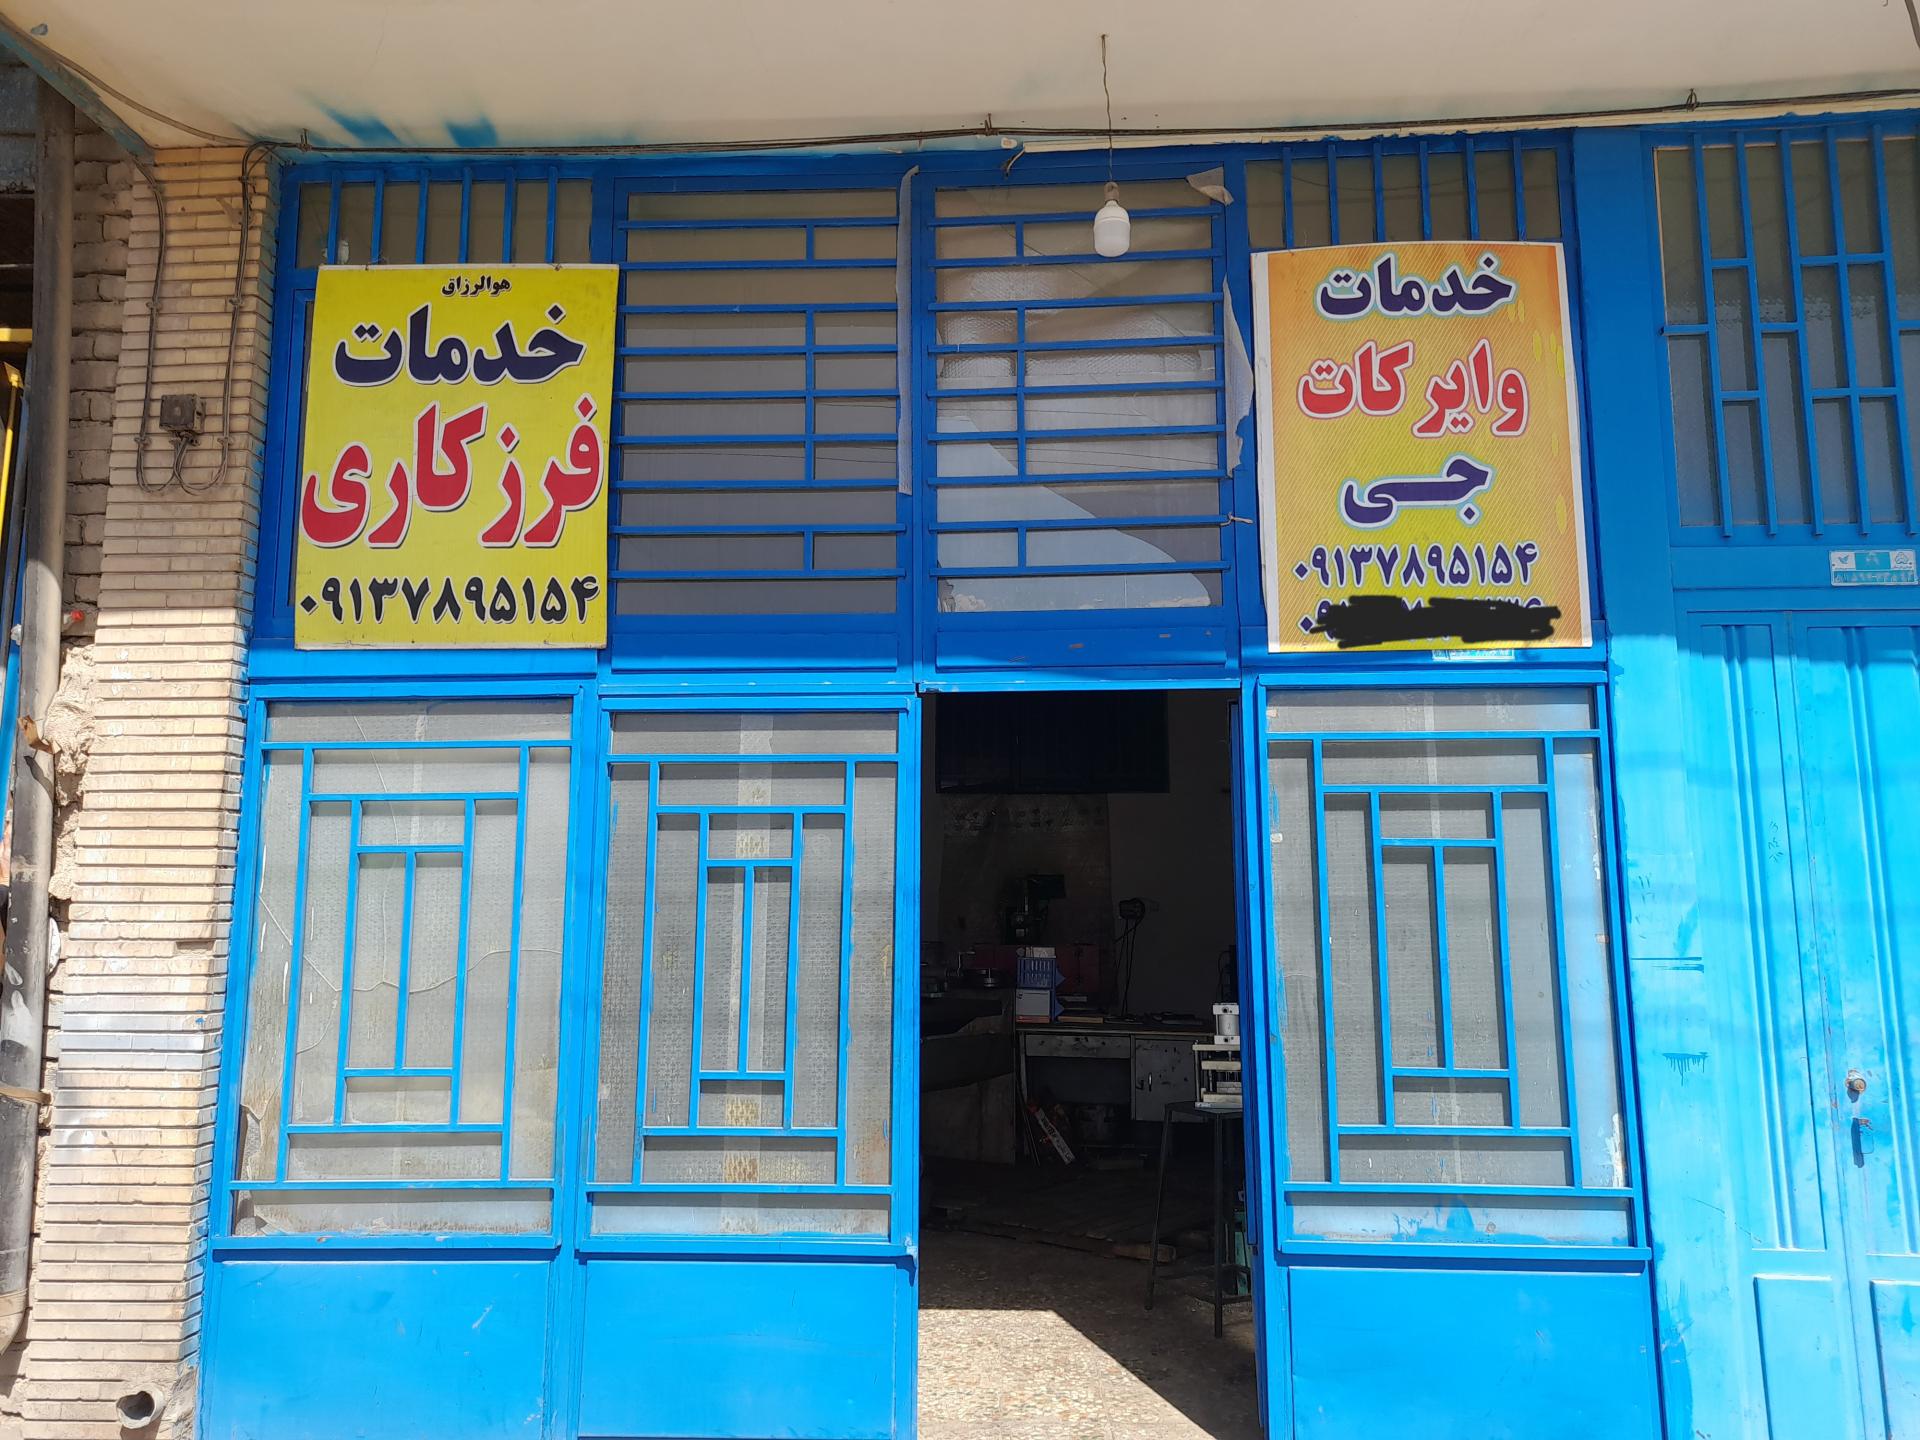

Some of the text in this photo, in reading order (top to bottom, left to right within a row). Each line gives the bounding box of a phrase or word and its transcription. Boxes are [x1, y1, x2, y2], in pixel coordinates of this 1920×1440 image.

[1318, 252, 1517, 317] خدمات
[334, 302, 587, 385] خدمات
[1293, 541, 1539, 587] ۰۹۱۳۷۸۹۵۱۵۴
[300, 575, 600, 624] ۰۹۱۳۷۸۹۵۱۵۴
